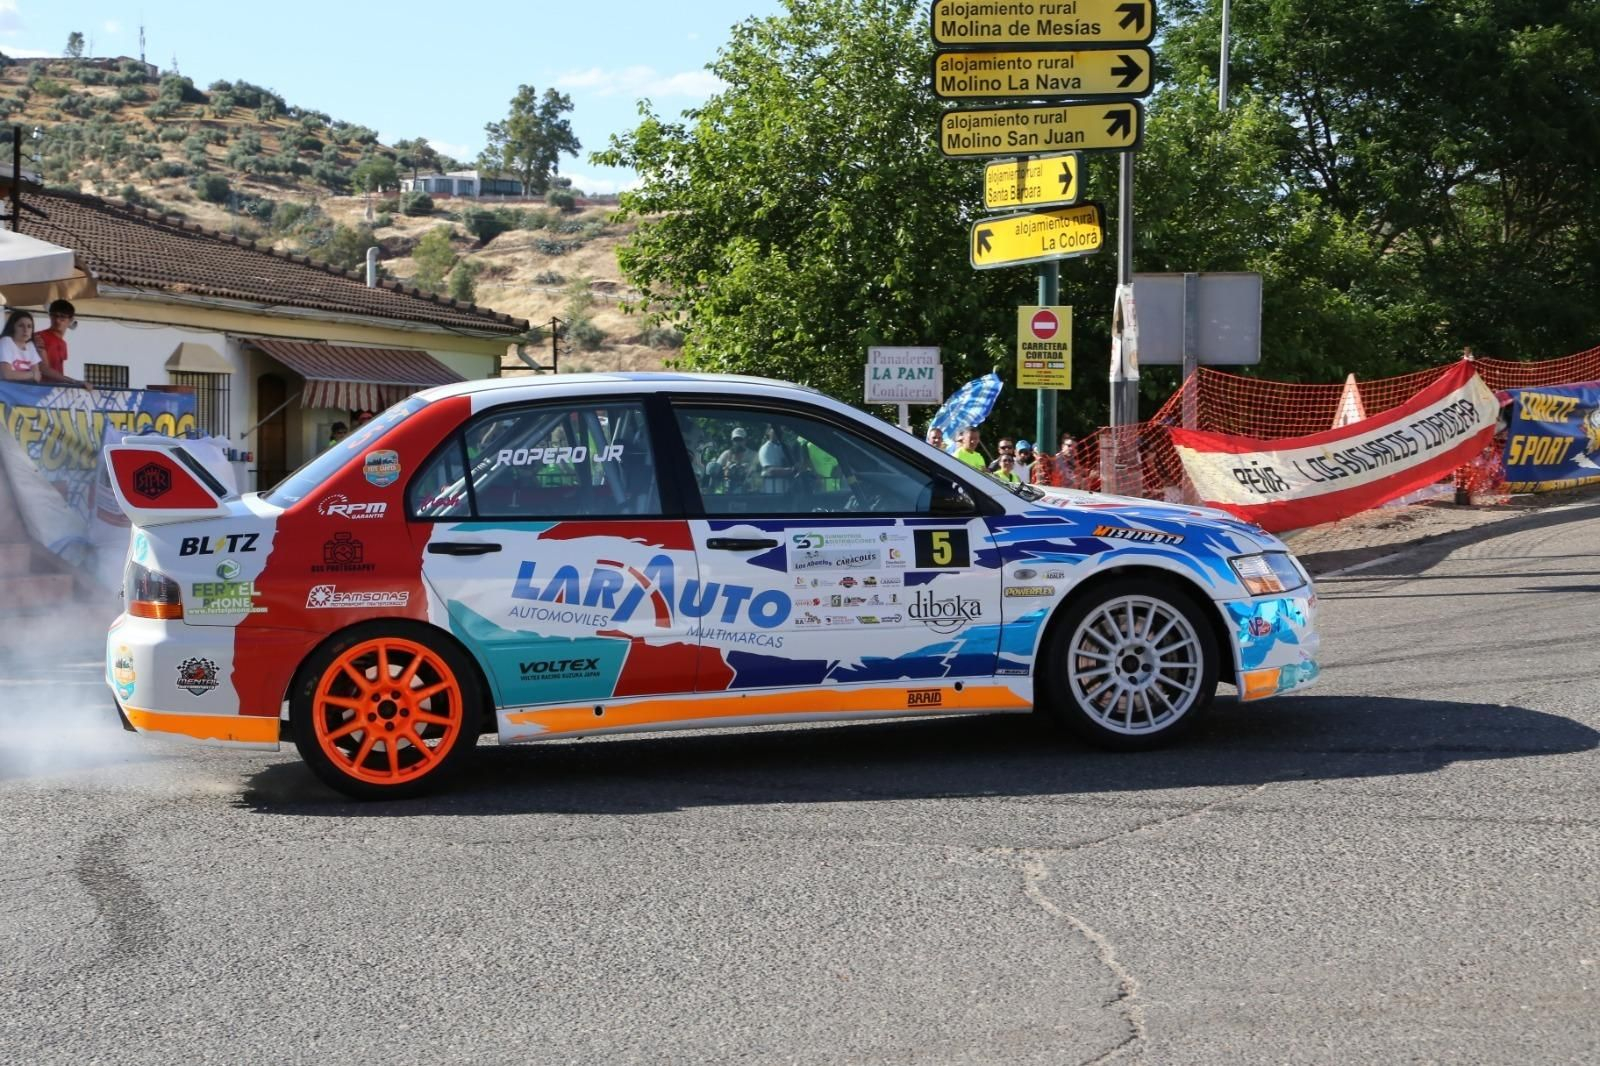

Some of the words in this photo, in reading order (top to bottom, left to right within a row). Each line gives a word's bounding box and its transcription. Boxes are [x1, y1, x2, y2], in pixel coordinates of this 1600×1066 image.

[941, 2, 1034, 19] alojamiento
[1040, 1, 1076, 15] rural
[941, 20, 1001, 37] Molina
[1008, 20, 1030, 36] de
[1037, 19, 1101, 35] Mesías
[941, 56, 1032, 74] alojamiento
[1038, 55, 1074, 70] rural
[941, 76, 1001, 92] Molino
[1008, 75, 1029, 90] La
[1036, 74, 1081, 90] Nava
[947, 112, 1029, 131] alojamiento
[1034, 109, 1067, 125] rural
[947, 132, 1002, 149] Molino
[1007, 131, 1038, 146] San
[1044, 129, 1085, 144] Juan
[988, 167, 1025, 185] alojamiento
[1027, 164, 1043, 178] rural
[988, 187, 1008, 202] Santa
[1015, 217, 1070, 236] alojamiento
[1073, 209, 1096, 225] rural
[1041, 235, 1056, 251] La
[1059, 227, 1098, 248] Colorá
[1022, 342, 1068, 350] CARRETERA
[1026, 351, 1064, 359] CORTADA
[873, 351, 933, 364] Panadería
[872, 367, 891, 380] LA
[898, 367, 934, 380] PANI
[873, 383, 933, 397] Confitería
[496, 446, 587, 466] ROPERO
[593, 445, 624, 463] JR
[1507, 434, 1574, 466] SPORT
[1293, 455, 1349, 482] LOS
[327, 502, 387, 519] RPM
[932, 531, 952, 565] 5
[192, 582, 262, 598] FERTEL
[333, 592, 409, 602] SAMSONAS
[1006, 587, 1053, 597] POWERFLEX
[908, 590, 983, 621] diboka
[508, 605, 609, 628] AUTOMOVILES
[686, 626, 784, 649] MULTIMARCAS
[519, 658, 600, 674] VOLTEX
[908, 692, 942, 704] BRAID
